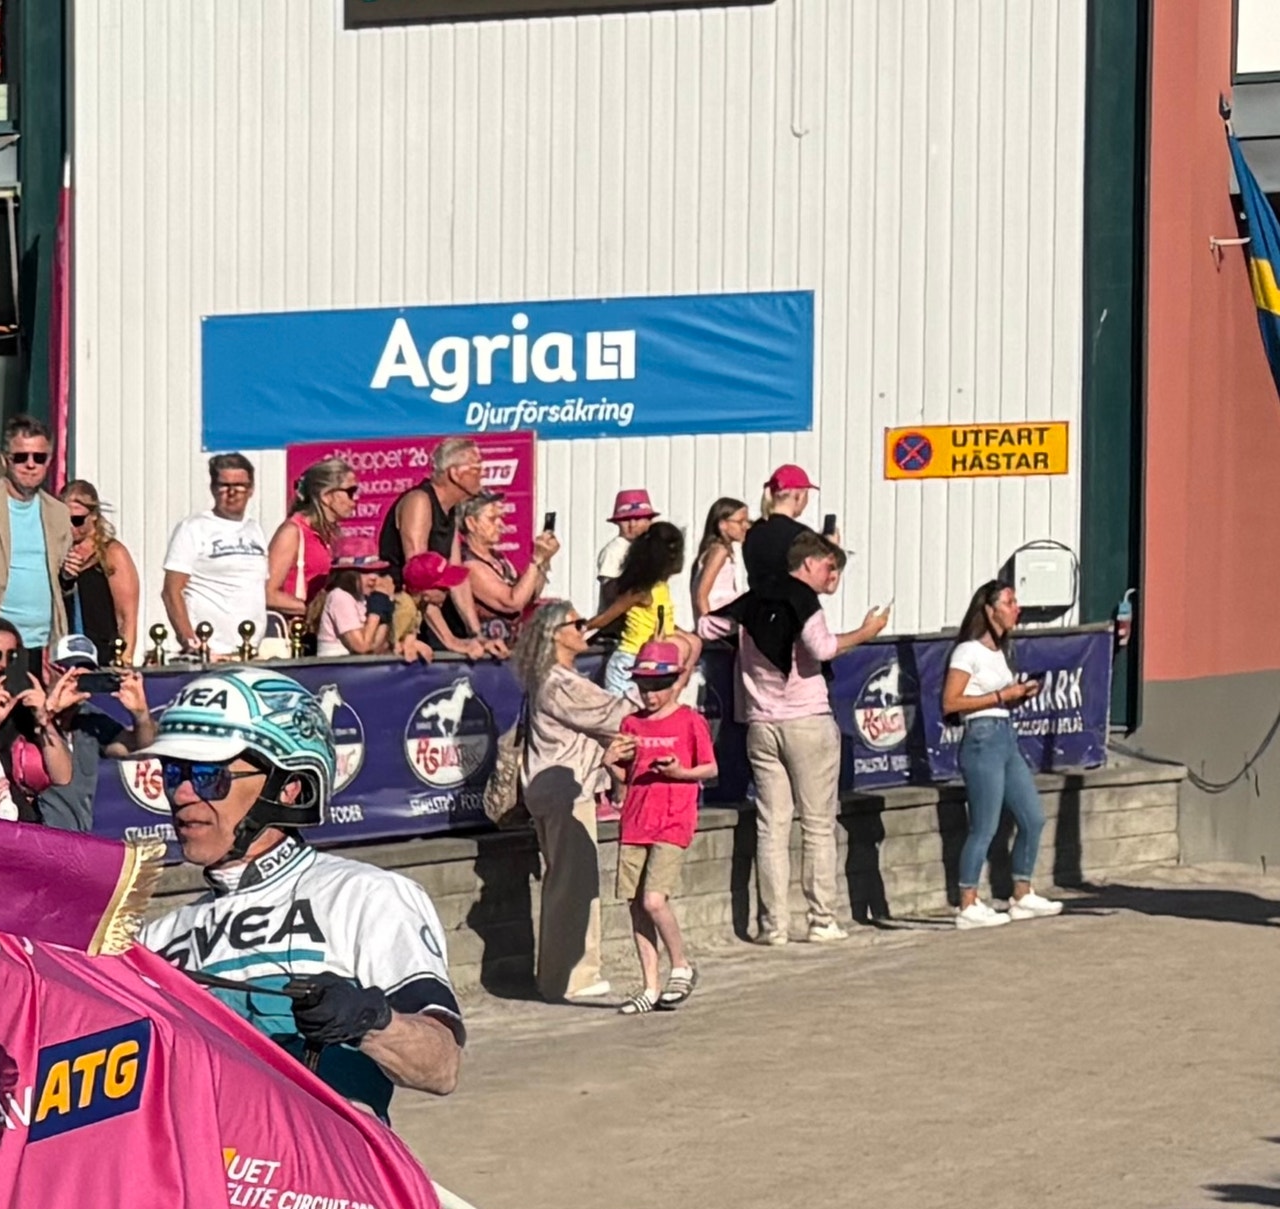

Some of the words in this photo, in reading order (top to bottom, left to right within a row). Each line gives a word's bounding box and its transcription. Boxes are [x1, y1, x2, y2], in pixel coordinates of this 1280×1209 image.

[369, 312, 577, 404] Agria
[465, 397, 635, 432] Djurförsäkring
[951, 427, 1051, 448] UTFART
[951, 450, 1050, 472] HÄSTAR
[166, 687, 230, 711] VEA
[329, 803, 365, 824] FODER
[35, 1039, 140, 1122] ATG
[227, 1154, 282, 1185] UET
